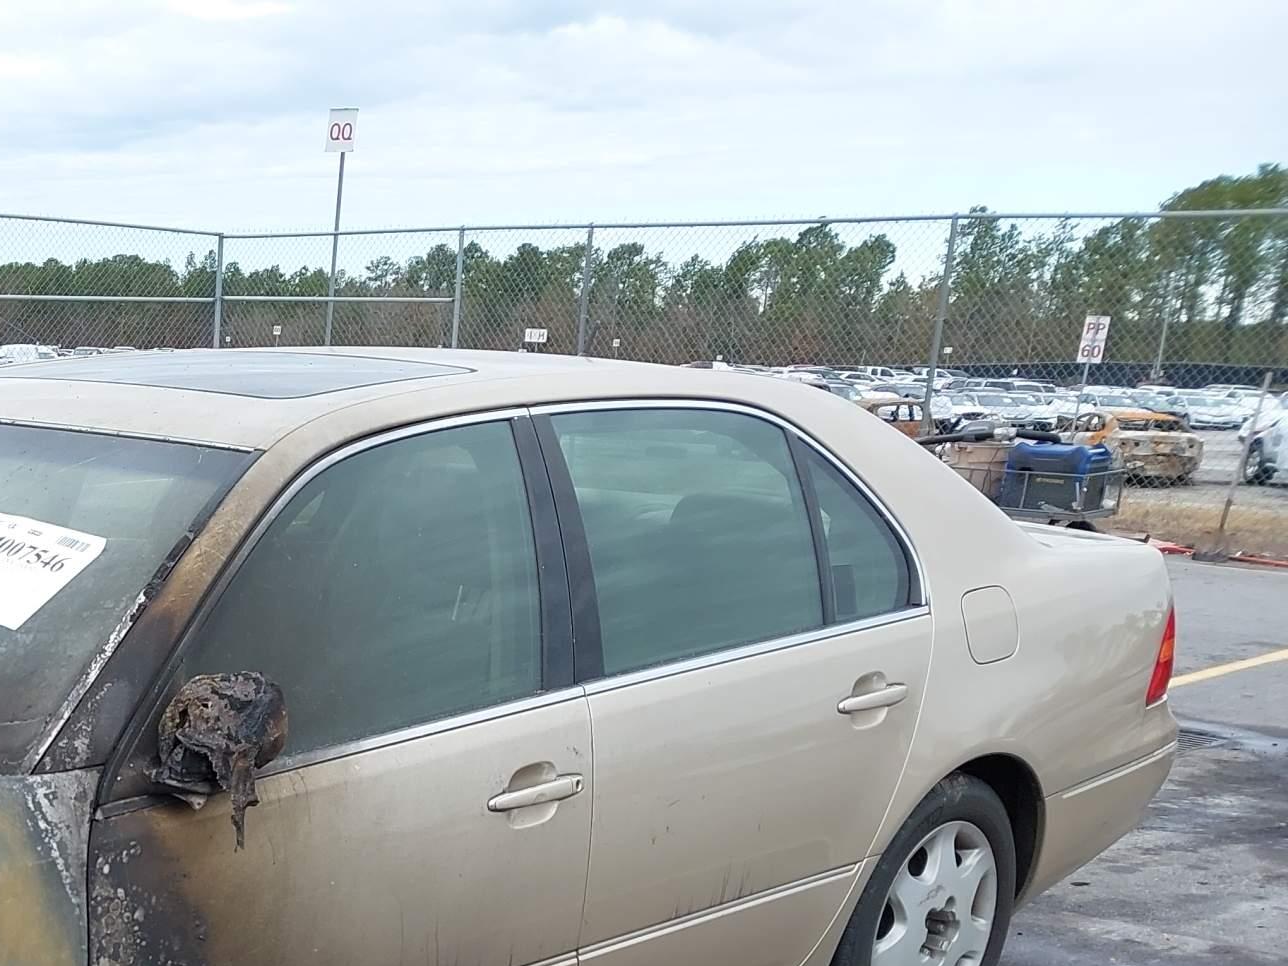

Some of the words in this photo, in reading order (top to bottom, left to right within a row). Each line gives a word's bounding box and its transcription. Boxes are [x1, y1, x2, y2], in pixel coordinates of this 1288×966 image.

[329, 122, 353, 141] QQ
[1086, 322, 1106, 335] PP
[1081, 344, 1101, 358] 60
